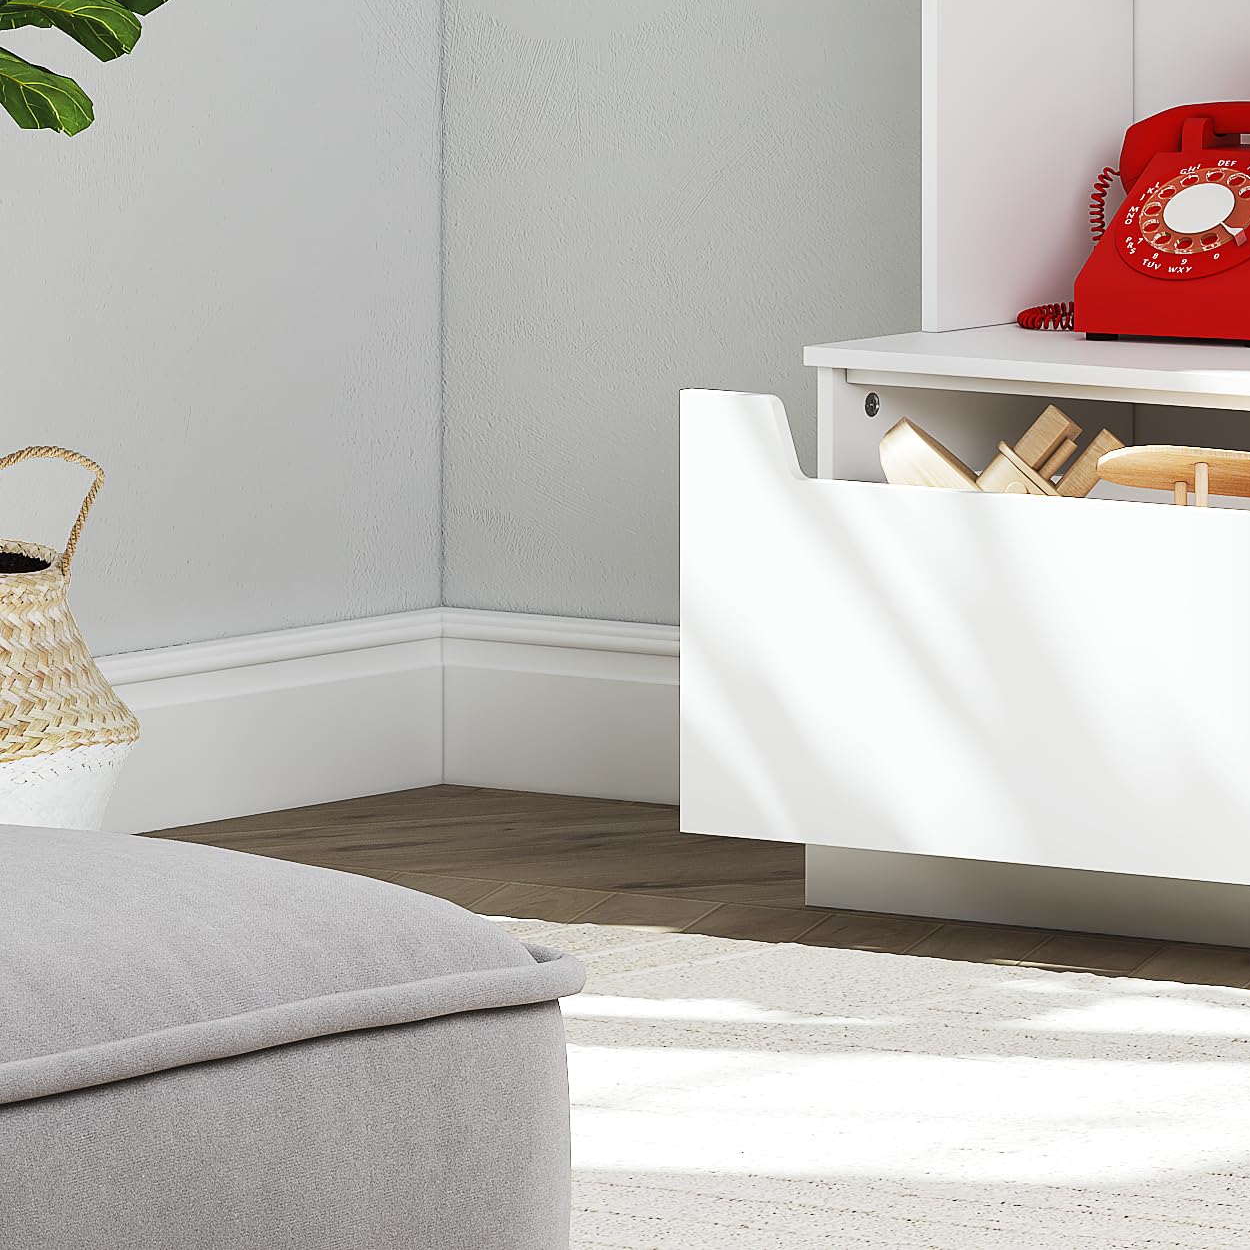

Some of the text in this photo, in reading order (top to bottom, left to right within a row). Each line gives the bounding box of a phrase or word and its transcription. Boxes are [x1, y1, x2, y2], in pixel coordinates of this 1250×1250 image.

[1217, 159, 1238, 167] DEF
[1180, 163, 1201, 175] GHI
[1124, 206, 1140, 225] MNO
[1125, 236, 1137, 255] PRS
[1137, 237, 1144, 245] 7
[1152, 252, 1159, 260] 8
[1142, 258, 1162, 270] TUV
[1168, 266, 1193, 274] WXY
